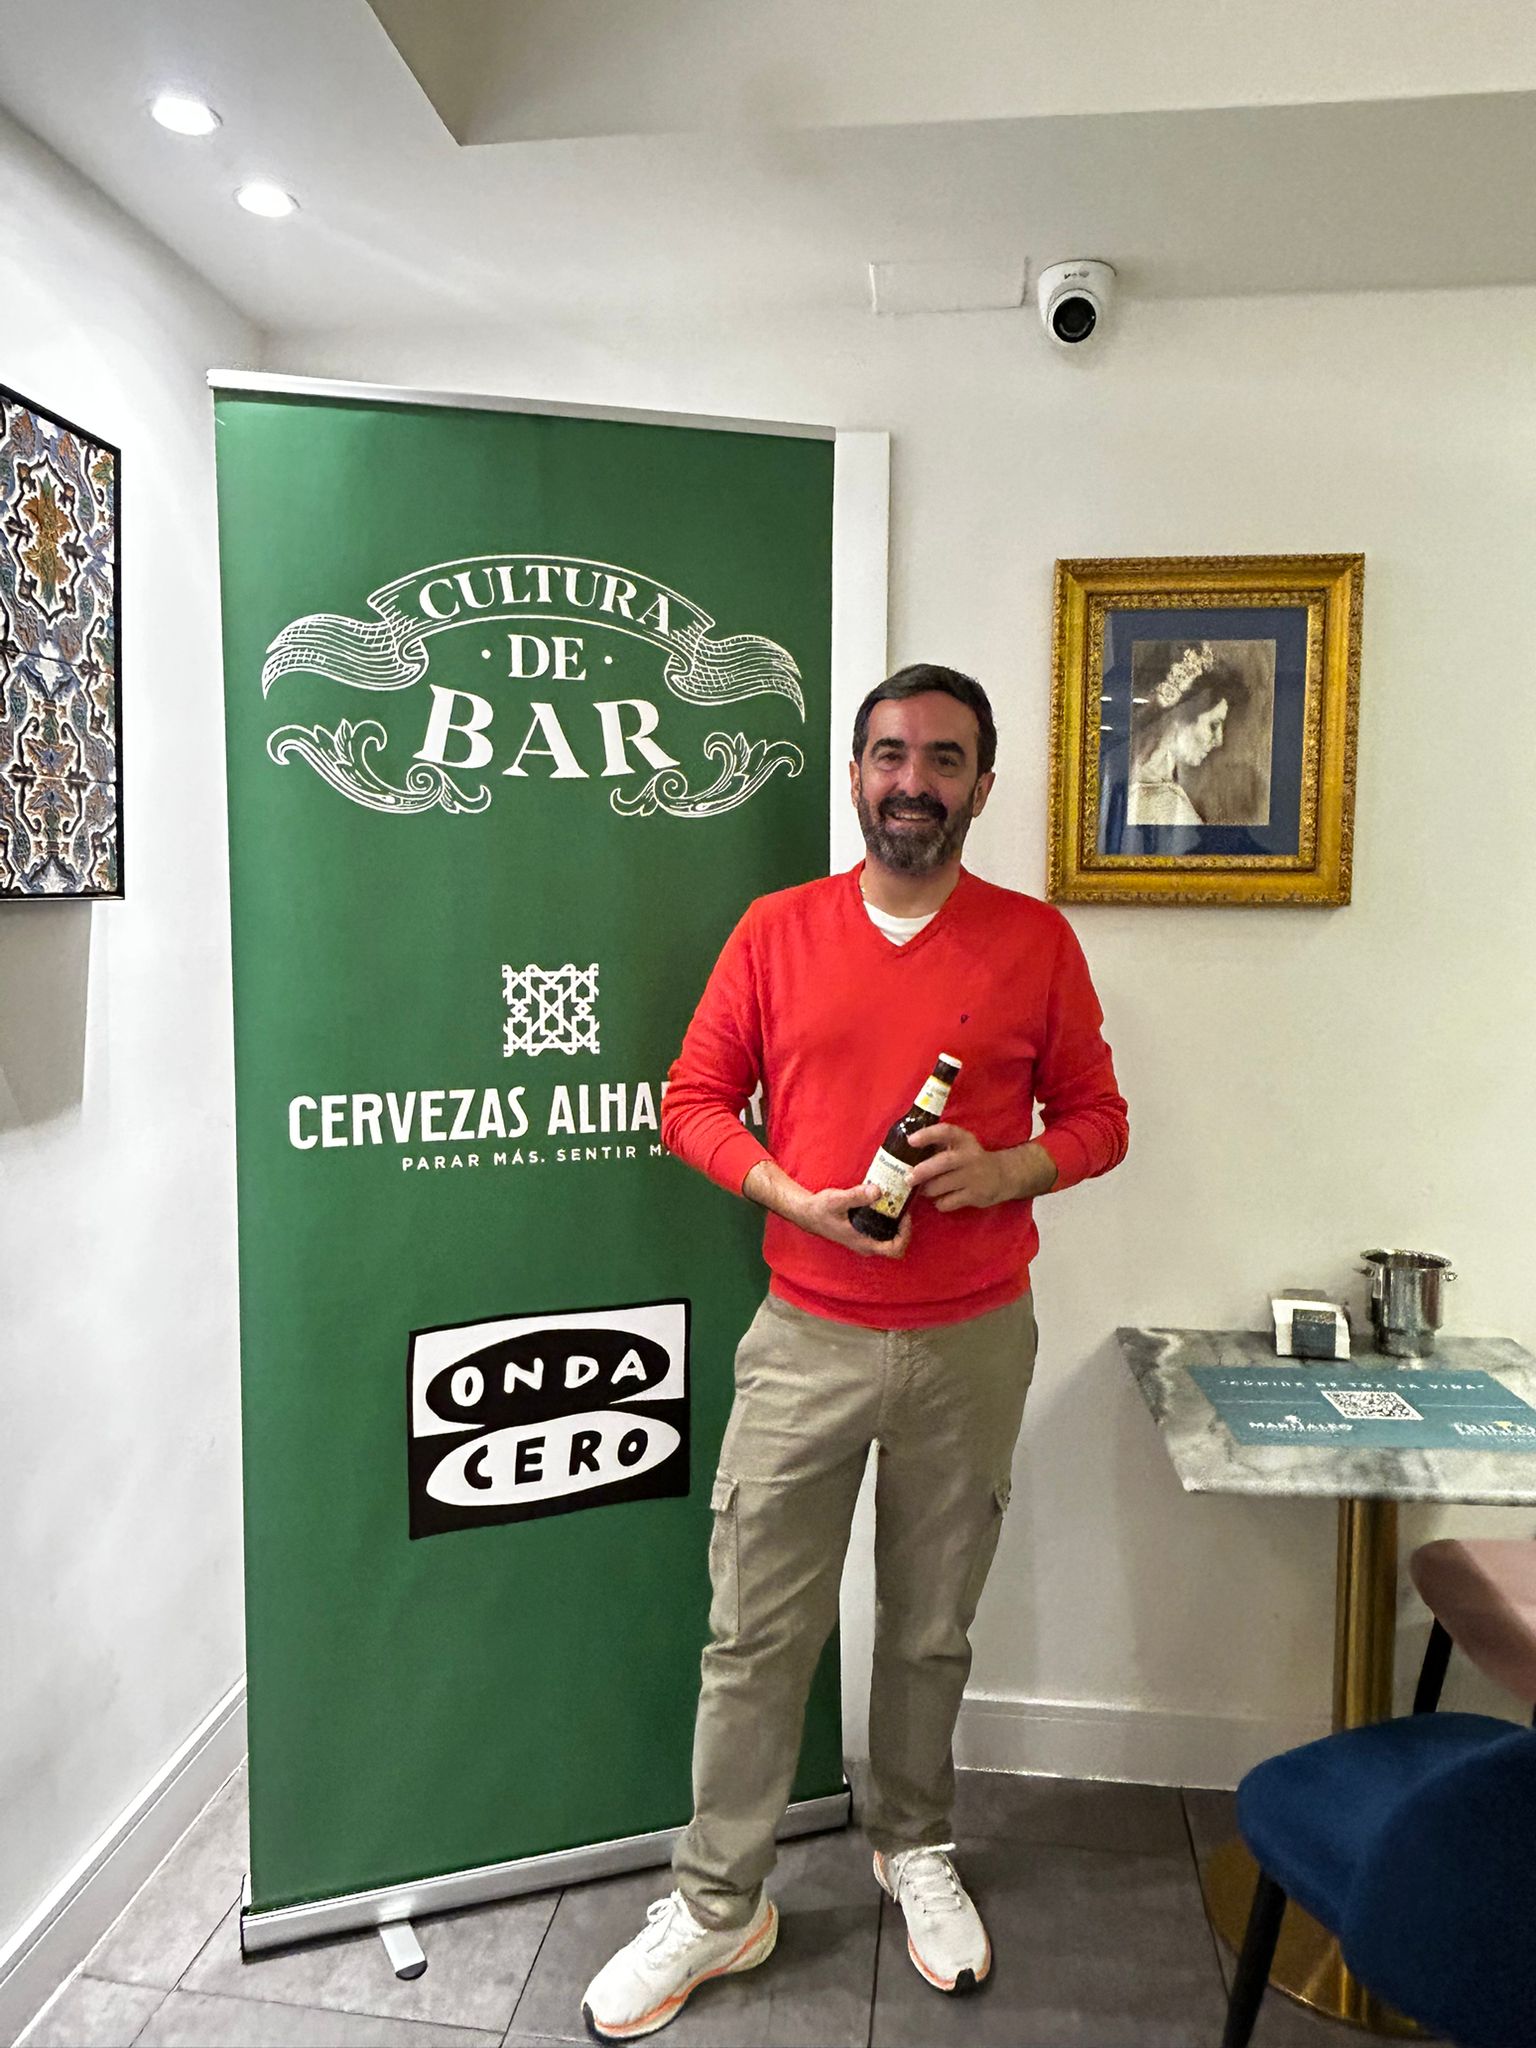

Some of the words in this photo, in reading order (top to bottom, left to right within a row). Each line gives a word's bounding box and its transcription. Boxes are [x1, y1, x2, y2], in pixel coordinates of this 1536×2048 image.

[418, 564, 670, 637] CULTURA
[507, 633, 587, 681] DE
[412, 683, 681, 779] BAR
[288, 1085, 529, 1150] CERVEZAS
[547, 1080, 763, 1136] ALHA
[401, 1153, 480, 1172] PARAR
[493, 1148, 545, 1166] MÁS.
[556, 1145, 636, 1162] SENTIR
[450, 1348, 647, 1407] ONDA
[463, 1427, 649, 1490] CERO
